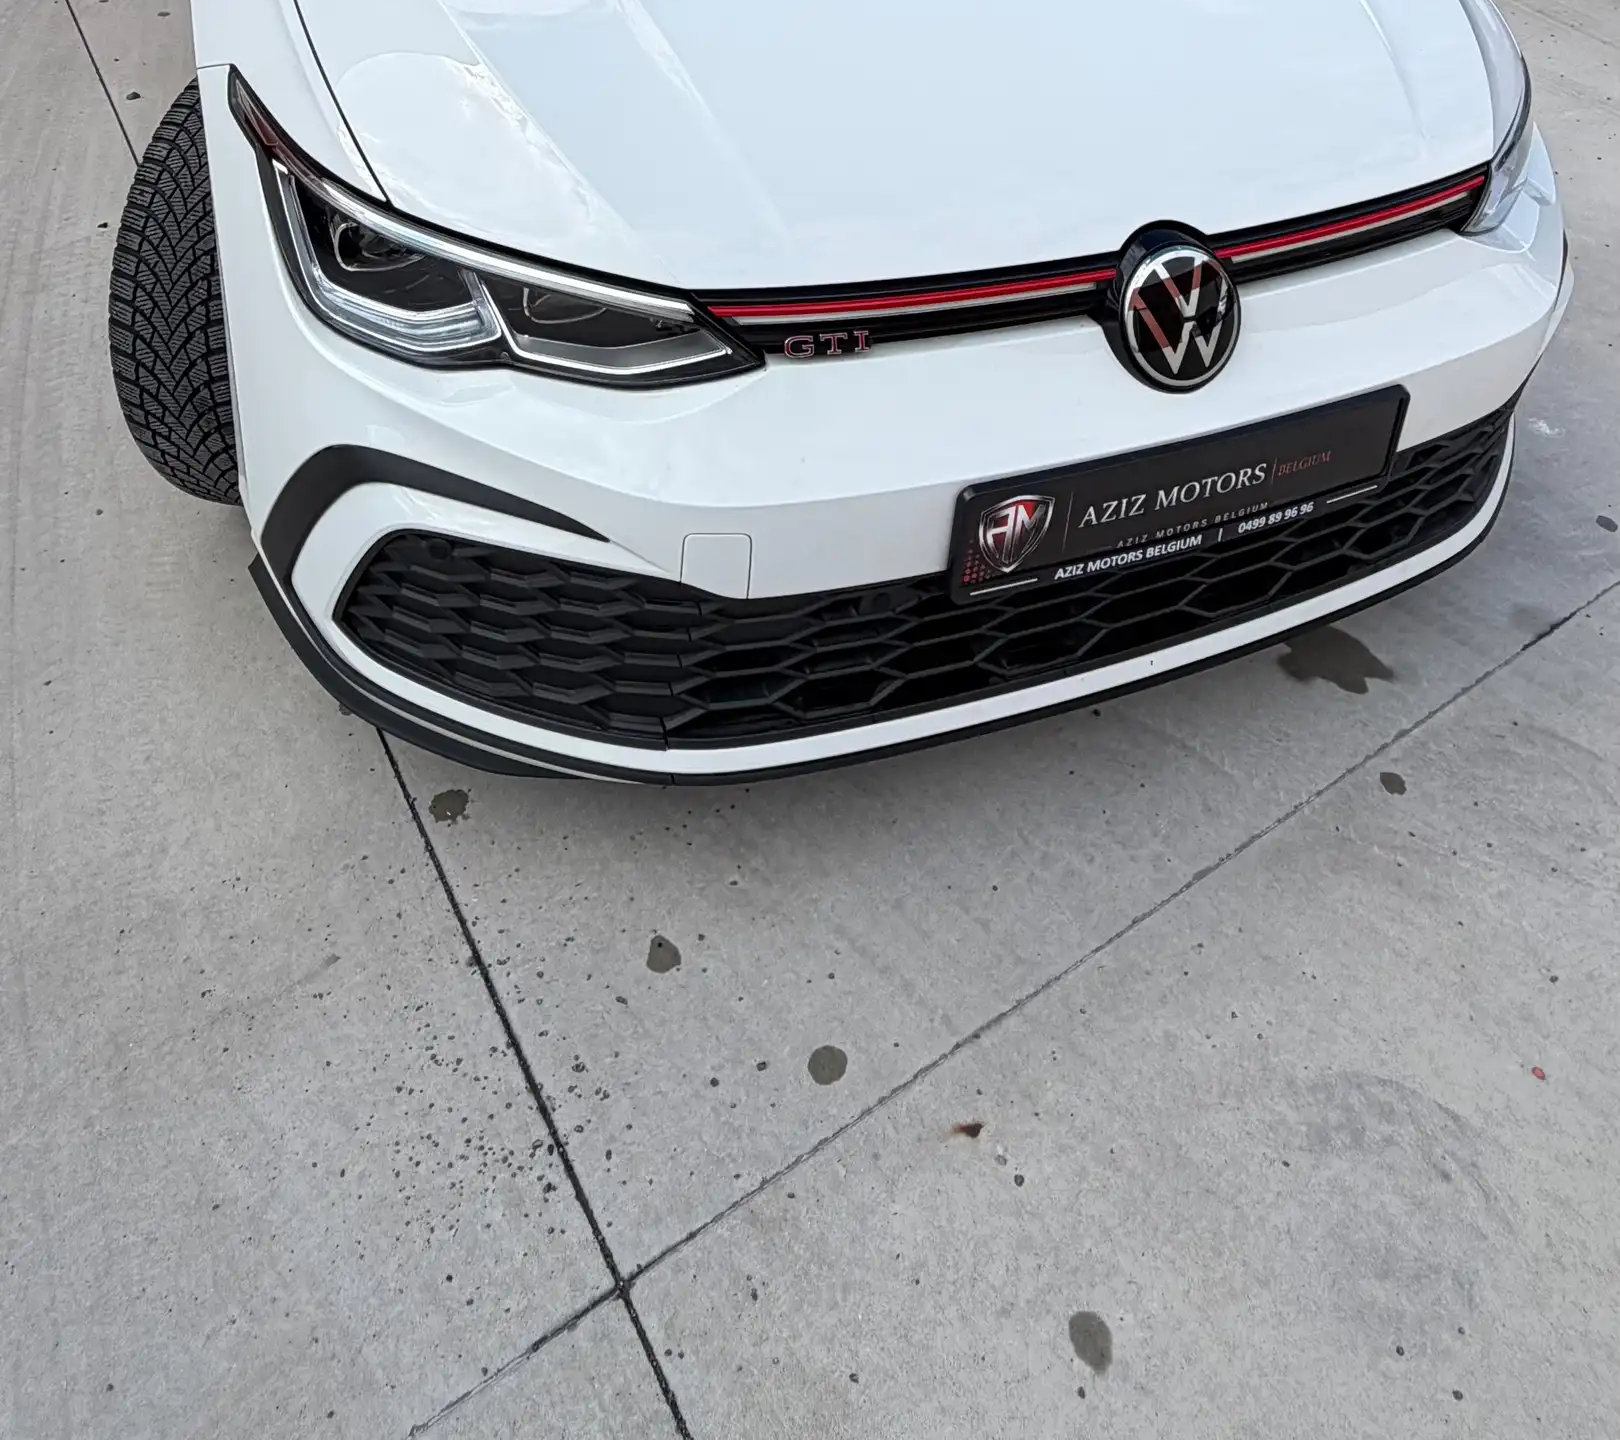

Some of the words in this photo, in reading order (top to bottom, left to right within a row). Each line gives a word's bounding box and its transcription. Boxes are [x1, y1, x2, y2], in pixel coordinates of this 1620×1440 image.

[784, 330, 869, 359] GTI
[1078, 494, 1147, 528] AZIZ
[1154, 463, 1267, 510] MOTORS
[1278, 450, 1332, 477] BELGIUM
[1054, 563, 1084, 580] AZIZ
[1087, 552, 1143, 573] MOTORS
[1146, 534, 1202, 558] BELGIUM
[1238, 516, 1265, 534] 0499
[1268, 512, 1282, 525] 89
[1283, 506, 1298, 520] 96
[1299, 501, 1315, 514] 96
[1116, 534, 1148, 549] AZIZ
[1155, 518, 1208, 539] MOTORS
[1214, 502, 1269, 524] BELGIUM
